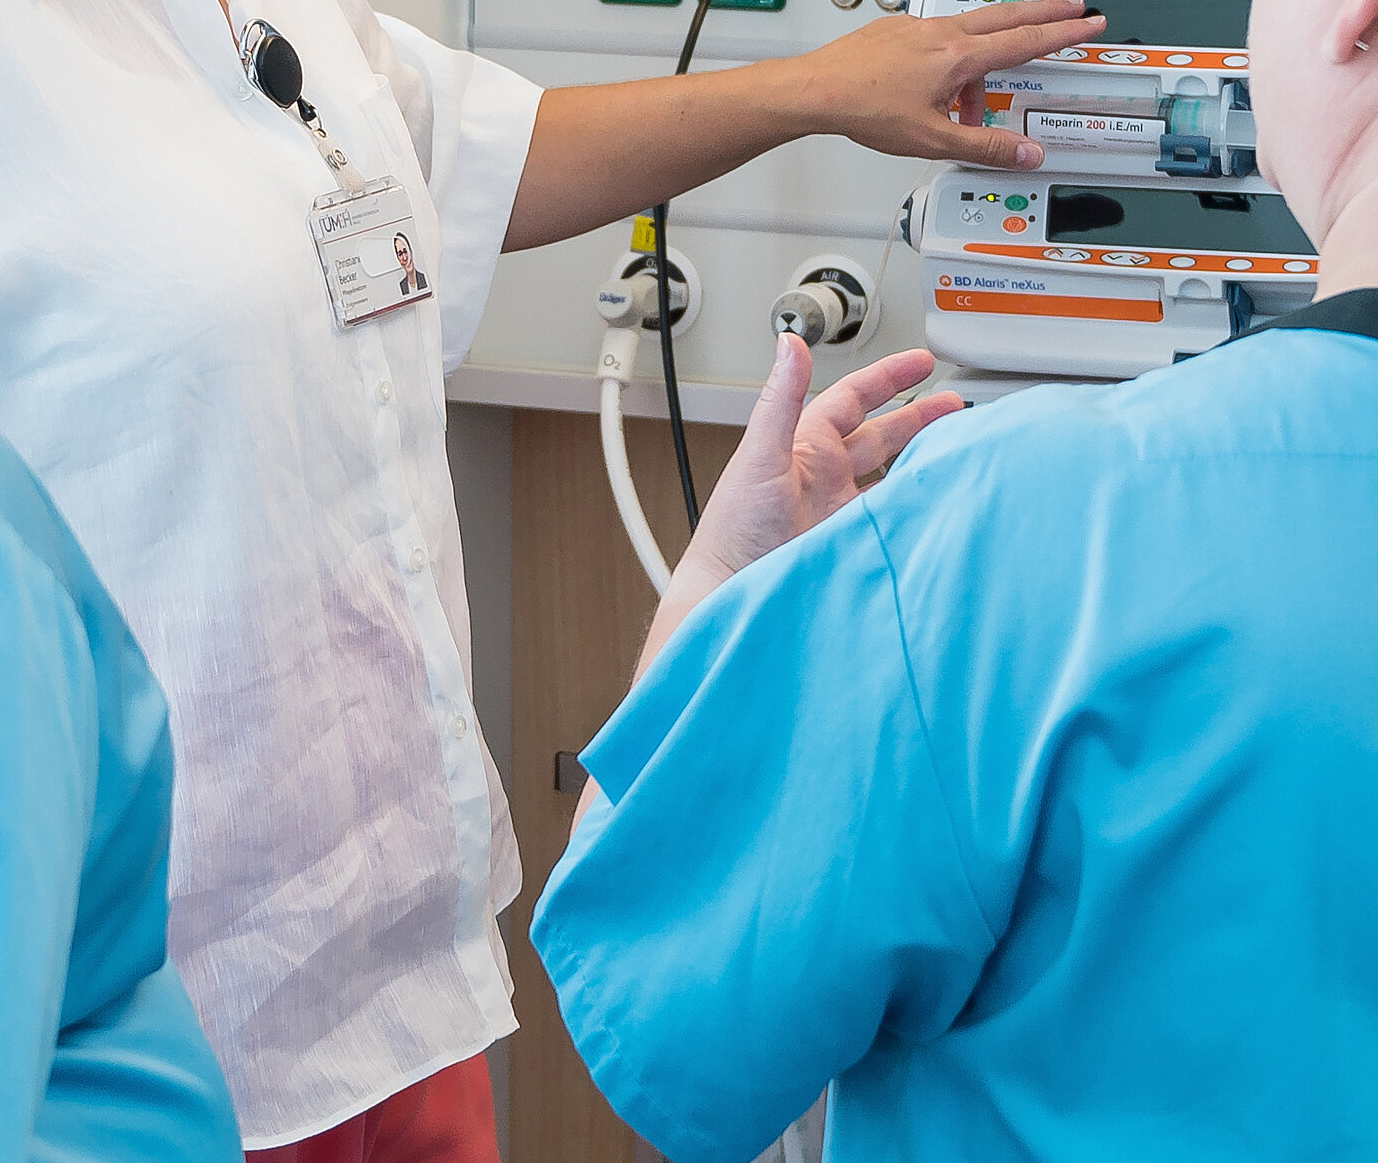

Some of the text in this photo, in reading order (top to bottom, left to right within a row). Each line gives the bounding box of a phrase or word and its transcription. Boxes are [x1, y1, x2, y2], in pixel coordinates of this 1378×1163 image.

[1009, 80, 1043, 91] neXus
[1040, 116, 1083, 129] Heparin
[1086, 119, 1106, 130] 200
[820, 270, 839, 281] AIR
[954, 276, 971, 286] BD
[1011, 279, 1045, 291] neXus
[955, 295, 972, 306] CC
